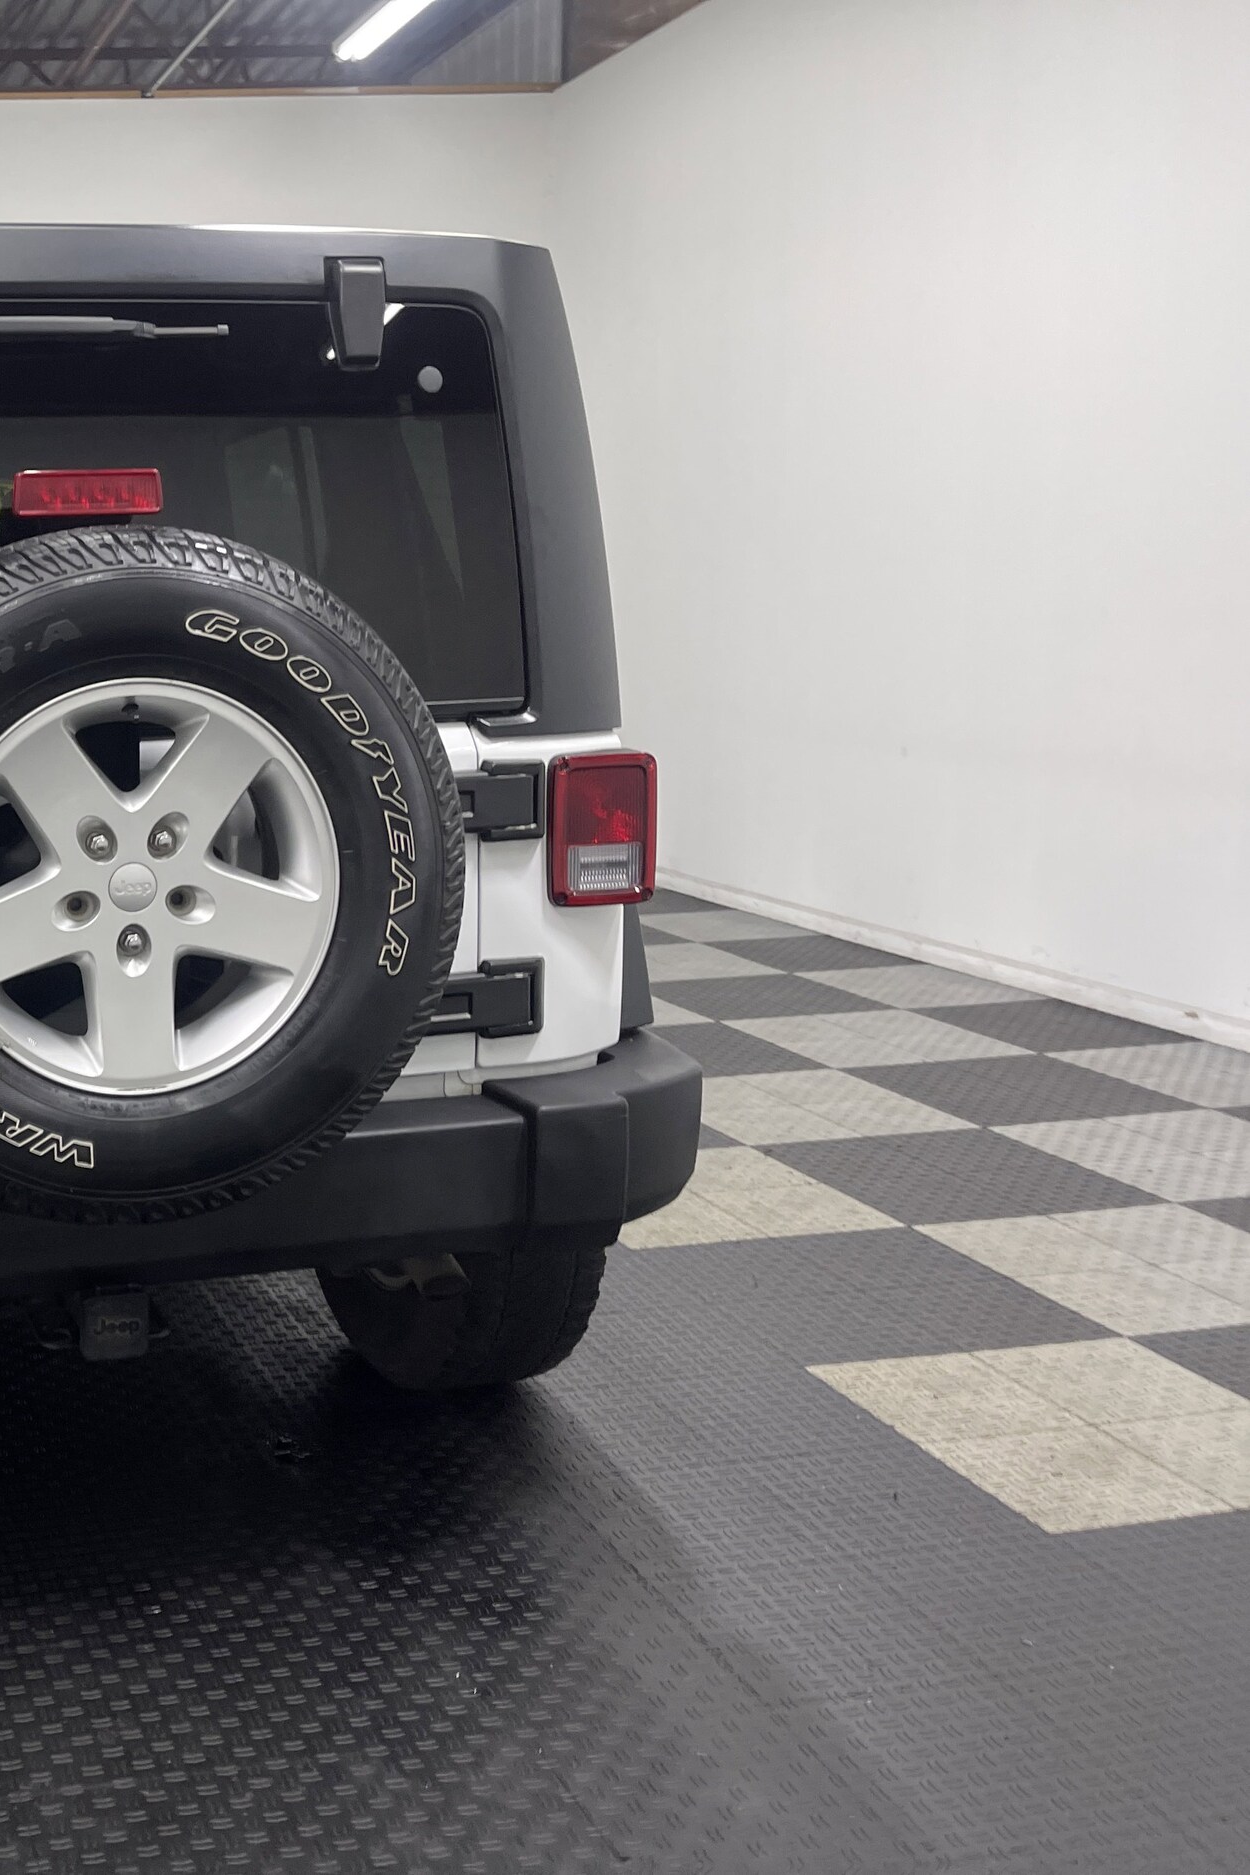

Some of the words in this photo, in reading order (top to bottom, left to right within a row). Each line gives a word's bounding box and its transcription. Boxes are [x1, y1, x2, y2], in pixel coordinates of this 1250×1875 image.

[185, 608, 417, 976] GOODYEAR
[114, 879, 152, 897] Jeep
[94, 1317, 141, 1335] Jeep
